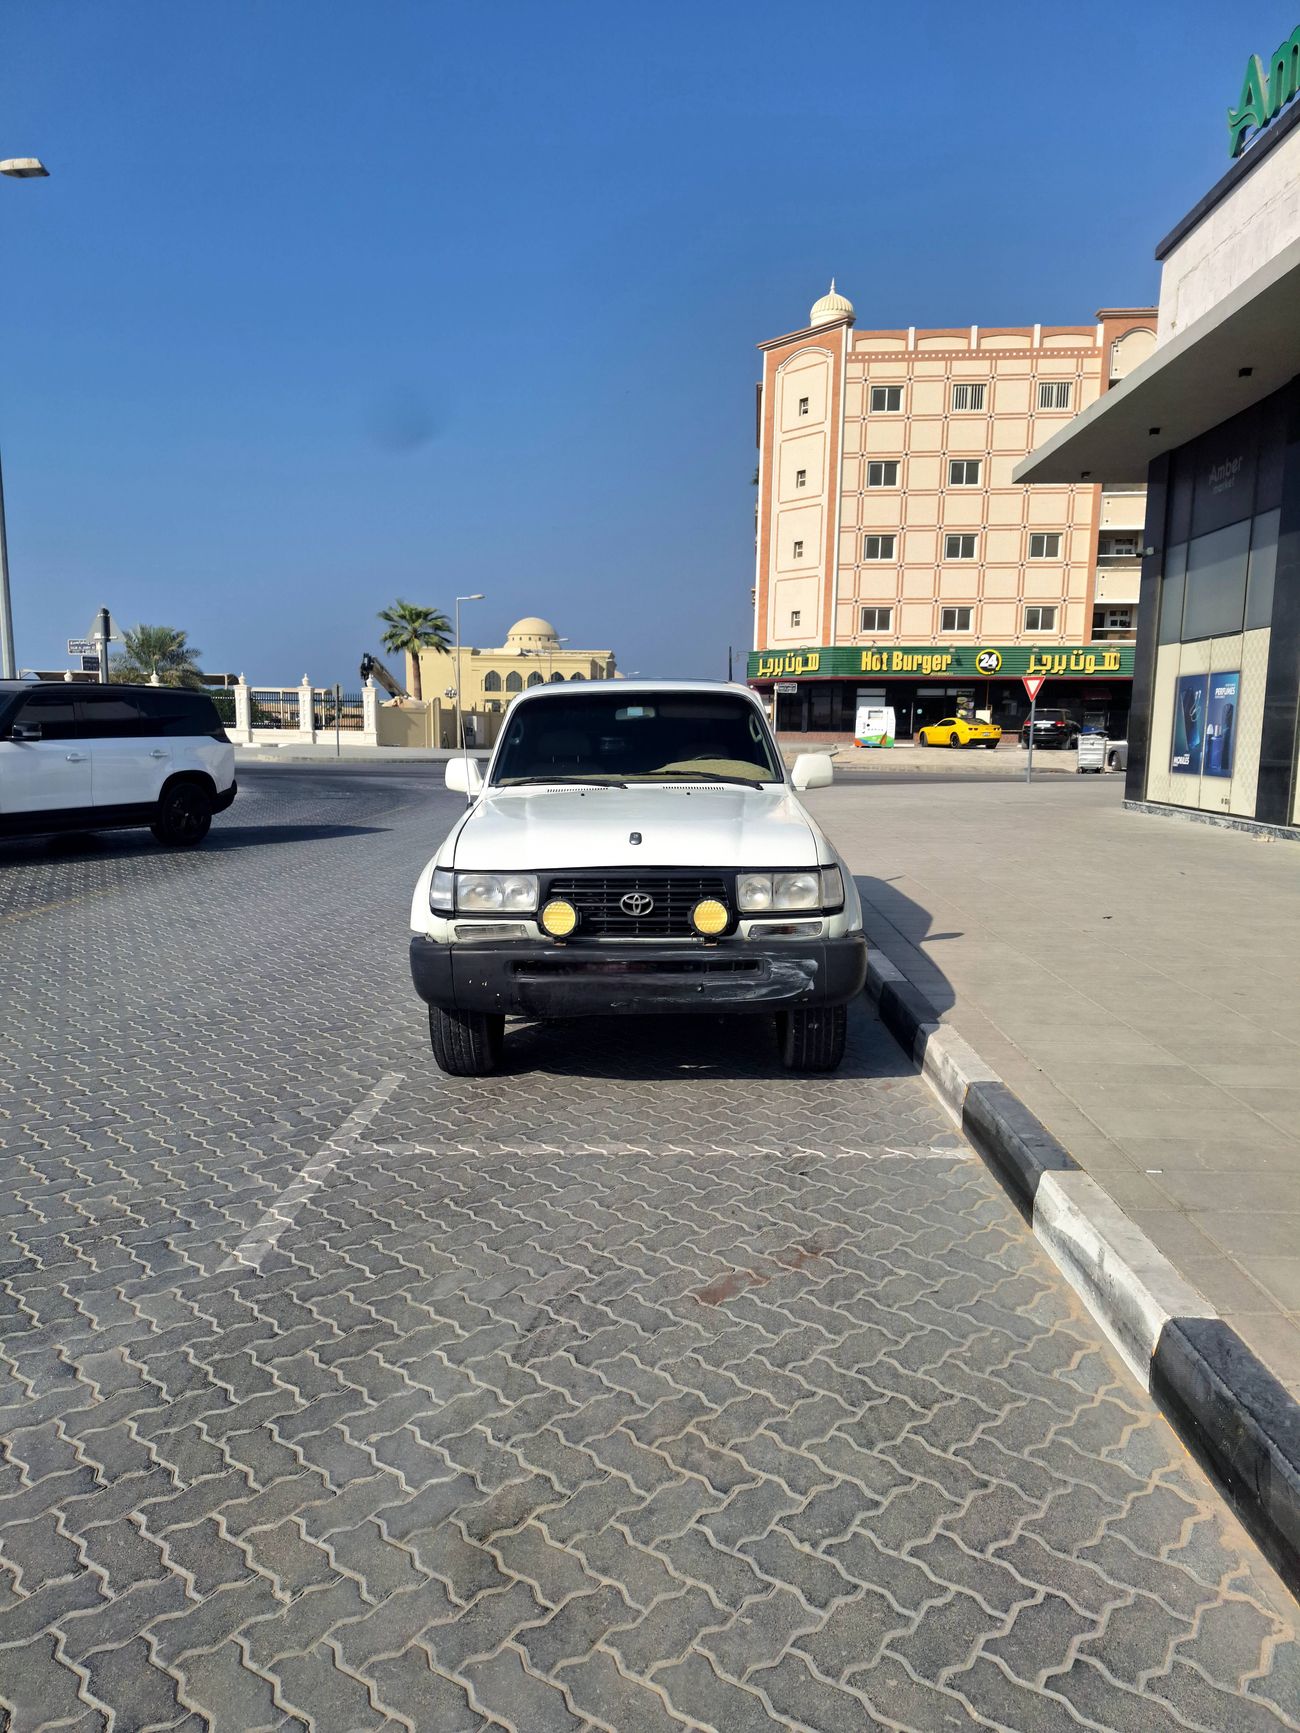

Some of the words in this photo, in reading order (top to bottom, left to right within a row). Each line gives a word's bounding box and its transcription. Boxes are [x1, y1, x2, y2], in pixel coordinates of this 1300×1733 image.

[1209, 456, 1243, 486] Amber
[757, 657, 783, 678] برجر
[861, 651, 888, 671] Hot
[892, 651, 951, 675] Burger
[980, 654, 998, 669] 24
[1026, 655, 1067, 675] برجر
